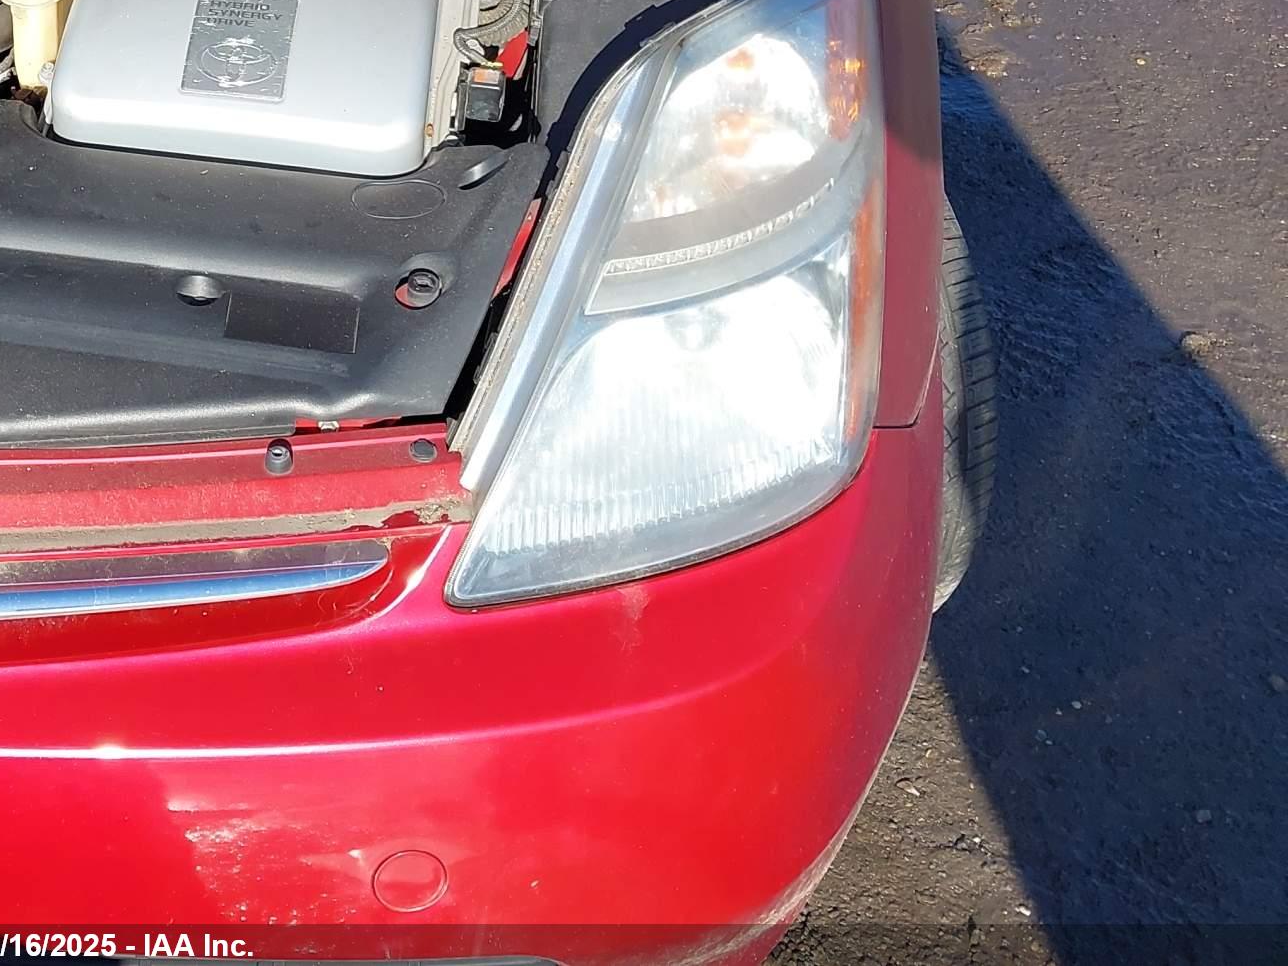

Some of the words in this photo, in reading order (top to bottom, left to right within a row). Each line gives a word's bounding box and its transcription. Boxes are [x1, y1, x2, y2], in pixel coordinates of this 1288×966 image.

[210, 0, 270, 11] HYBRID
[208, 8, 283, 21] SYNERGY
[206, 17, 256, 27] DRIVE
